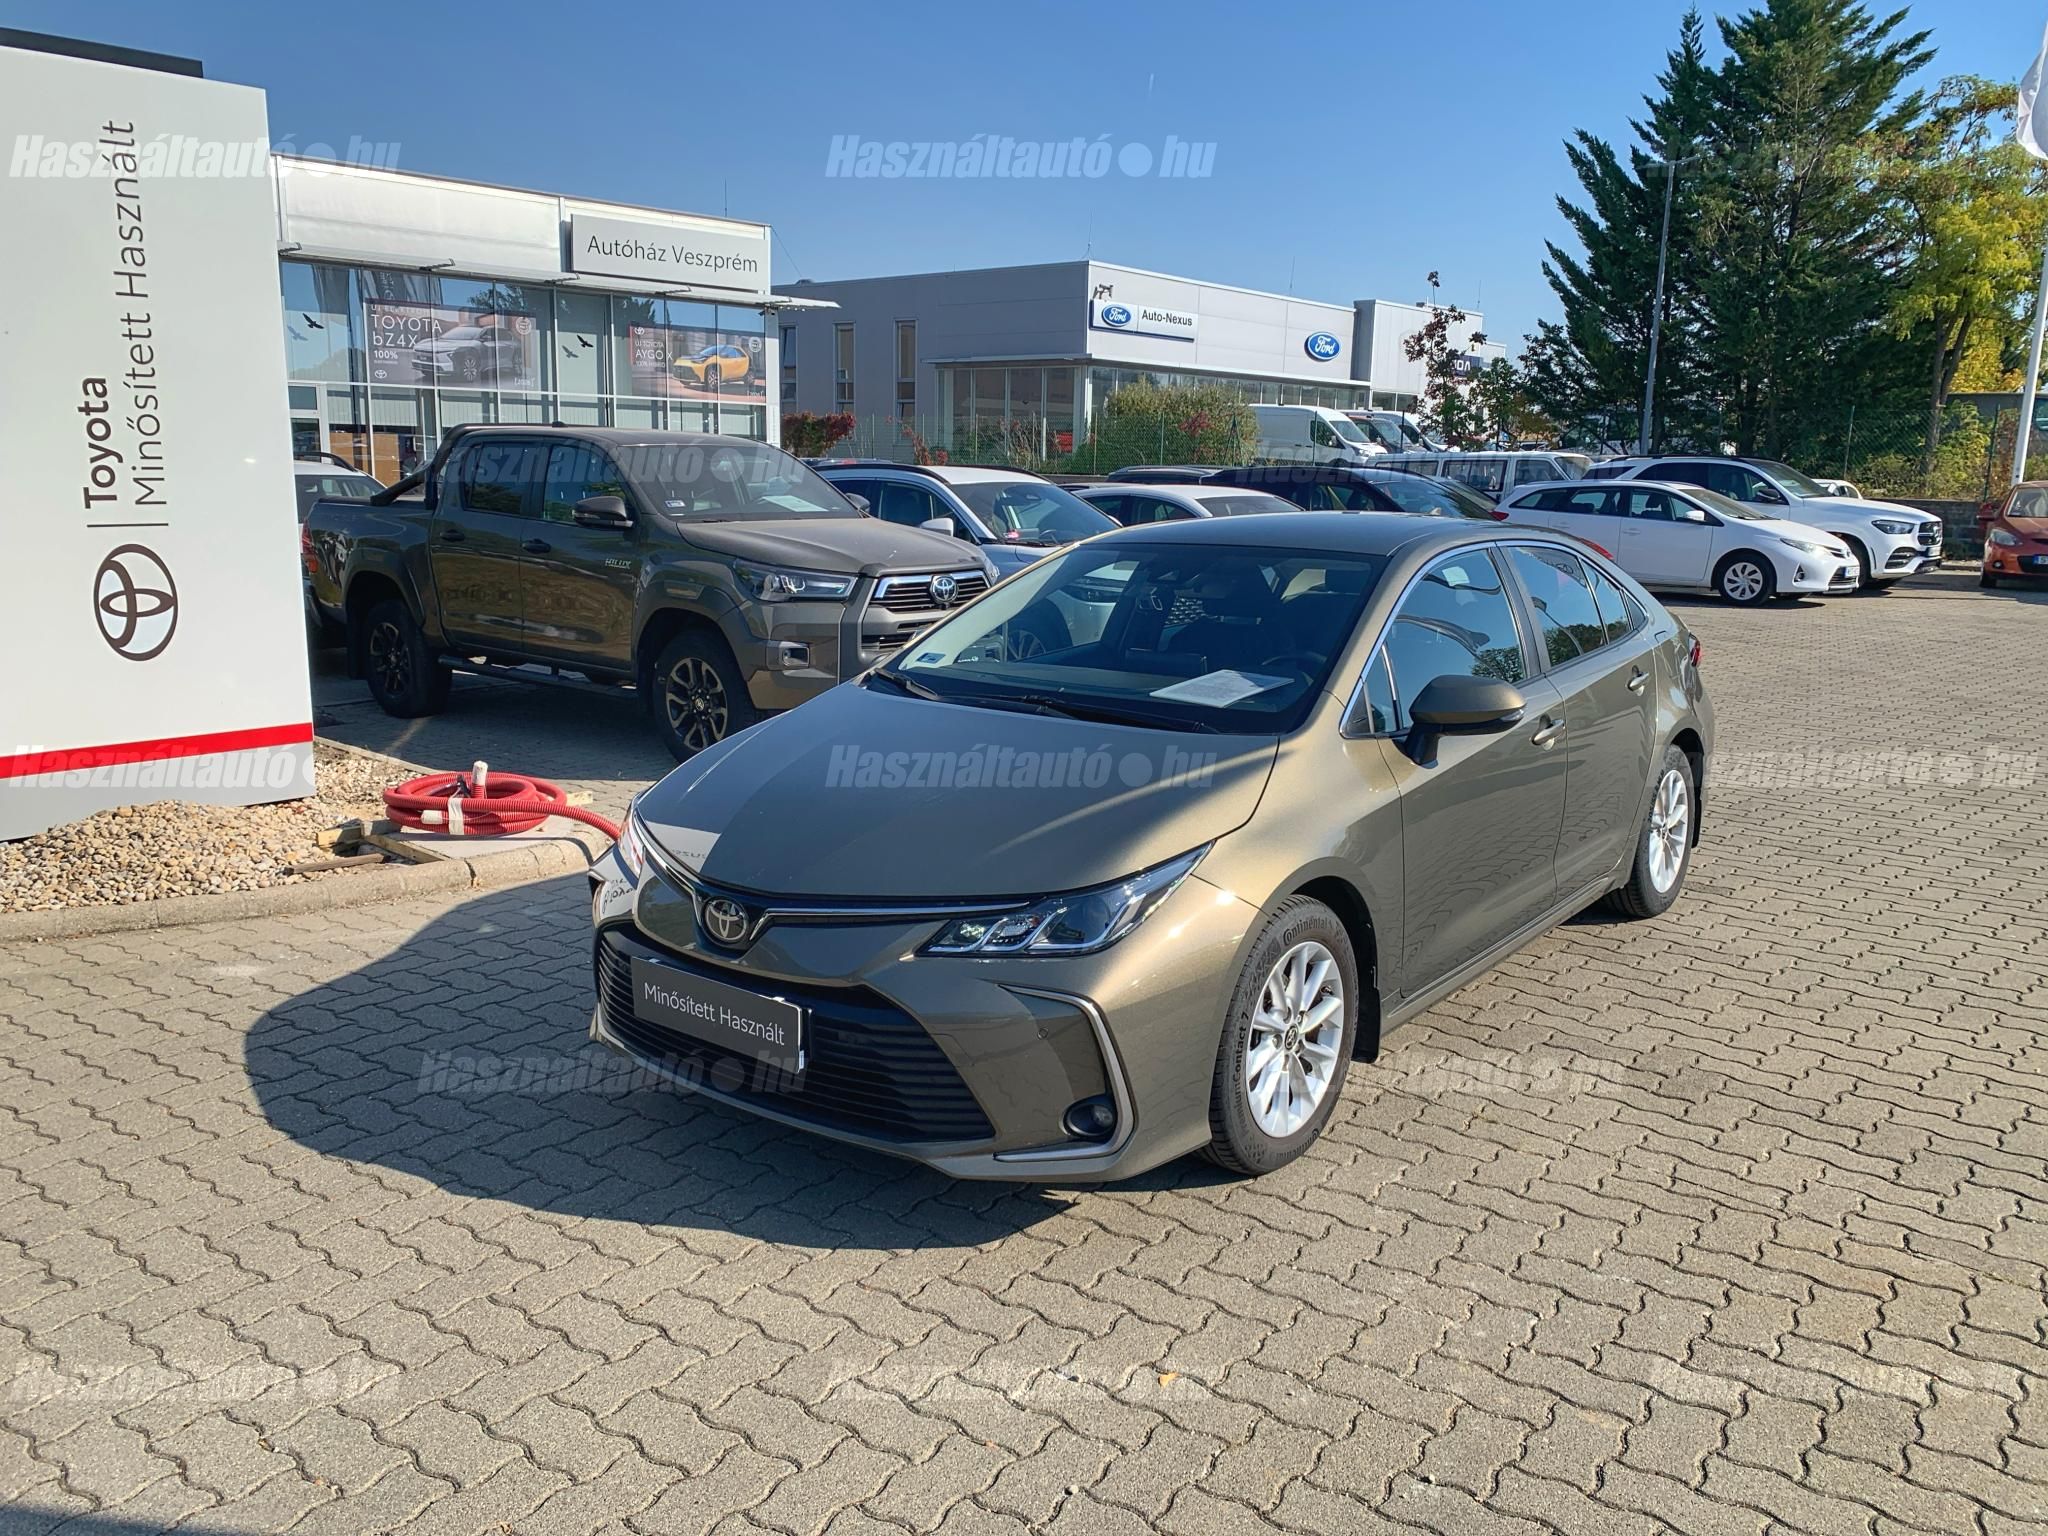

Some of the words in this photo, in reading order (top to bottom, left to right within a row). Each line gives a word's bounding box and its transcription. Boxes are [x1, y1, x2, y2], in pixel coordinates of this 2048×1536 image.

[99, 119, 149, 298] Használt
[587, 235, 666, 262] Autóház
[672, 245, 758, 273] Veszprém
[371, 314, 443, 334] TOYOTA
[1141, 309, 1193, 327] Auto-Nexus
[372, 331, 418, 348] bZ4X
[1314, 336, 1336, 355] Ford
[373, 350, 399, 360] 100%
[635, 349, 664, 360] AYGO
[667, 351, 673, 360] X
[120, 312, 168, 505] Minősített
[77, 377, 123, 509] Toyota
[605, 558, 632, 570] HILUX
[1283, 916, 1328, 946] Continental
[644, 982, 715, 1022] Minősített
[720, 1006, 785, 1046] Használt
